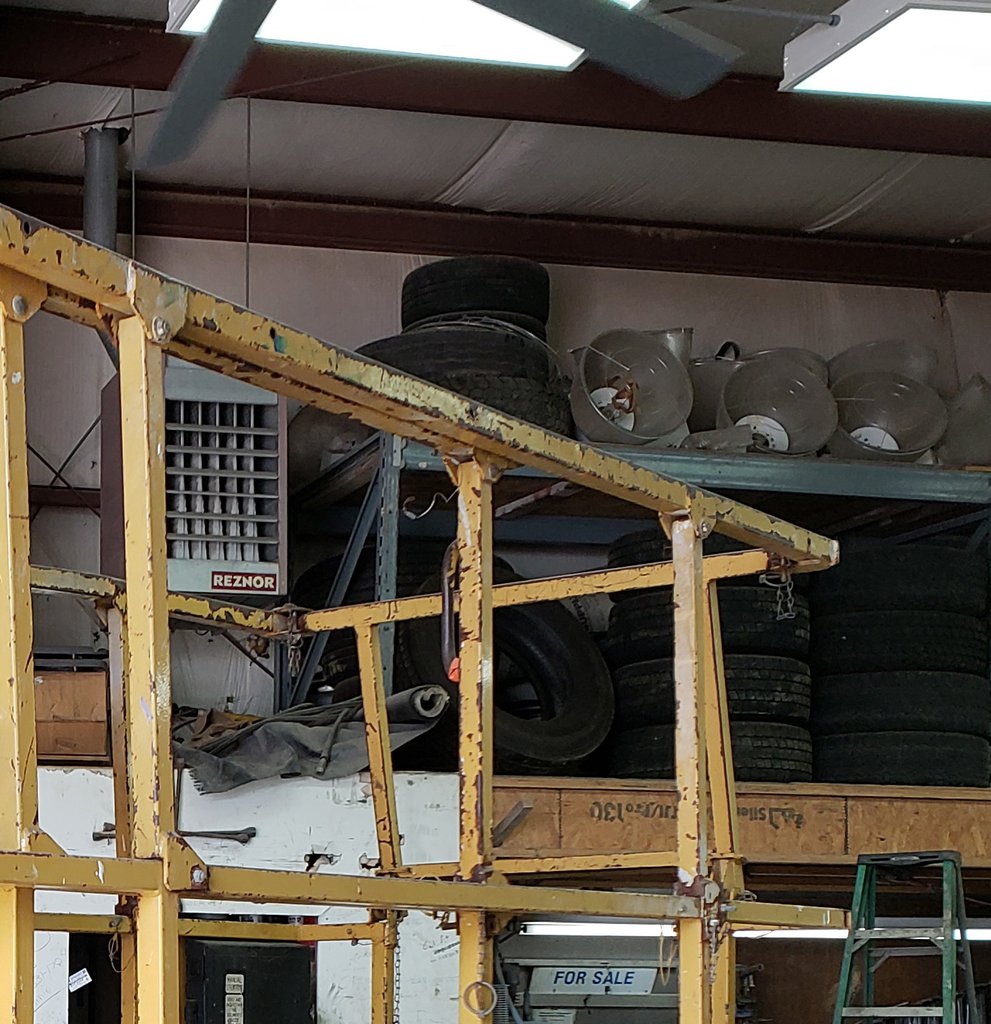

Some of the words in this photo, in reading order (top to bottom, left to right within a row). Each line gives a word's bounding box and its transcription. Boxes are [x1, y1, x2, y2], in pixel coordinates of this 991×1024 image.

[213, 574, 275, 589] REZNOR
[553, 971, 587, 985] FOR
[592, 971, 635, 985] SALE
